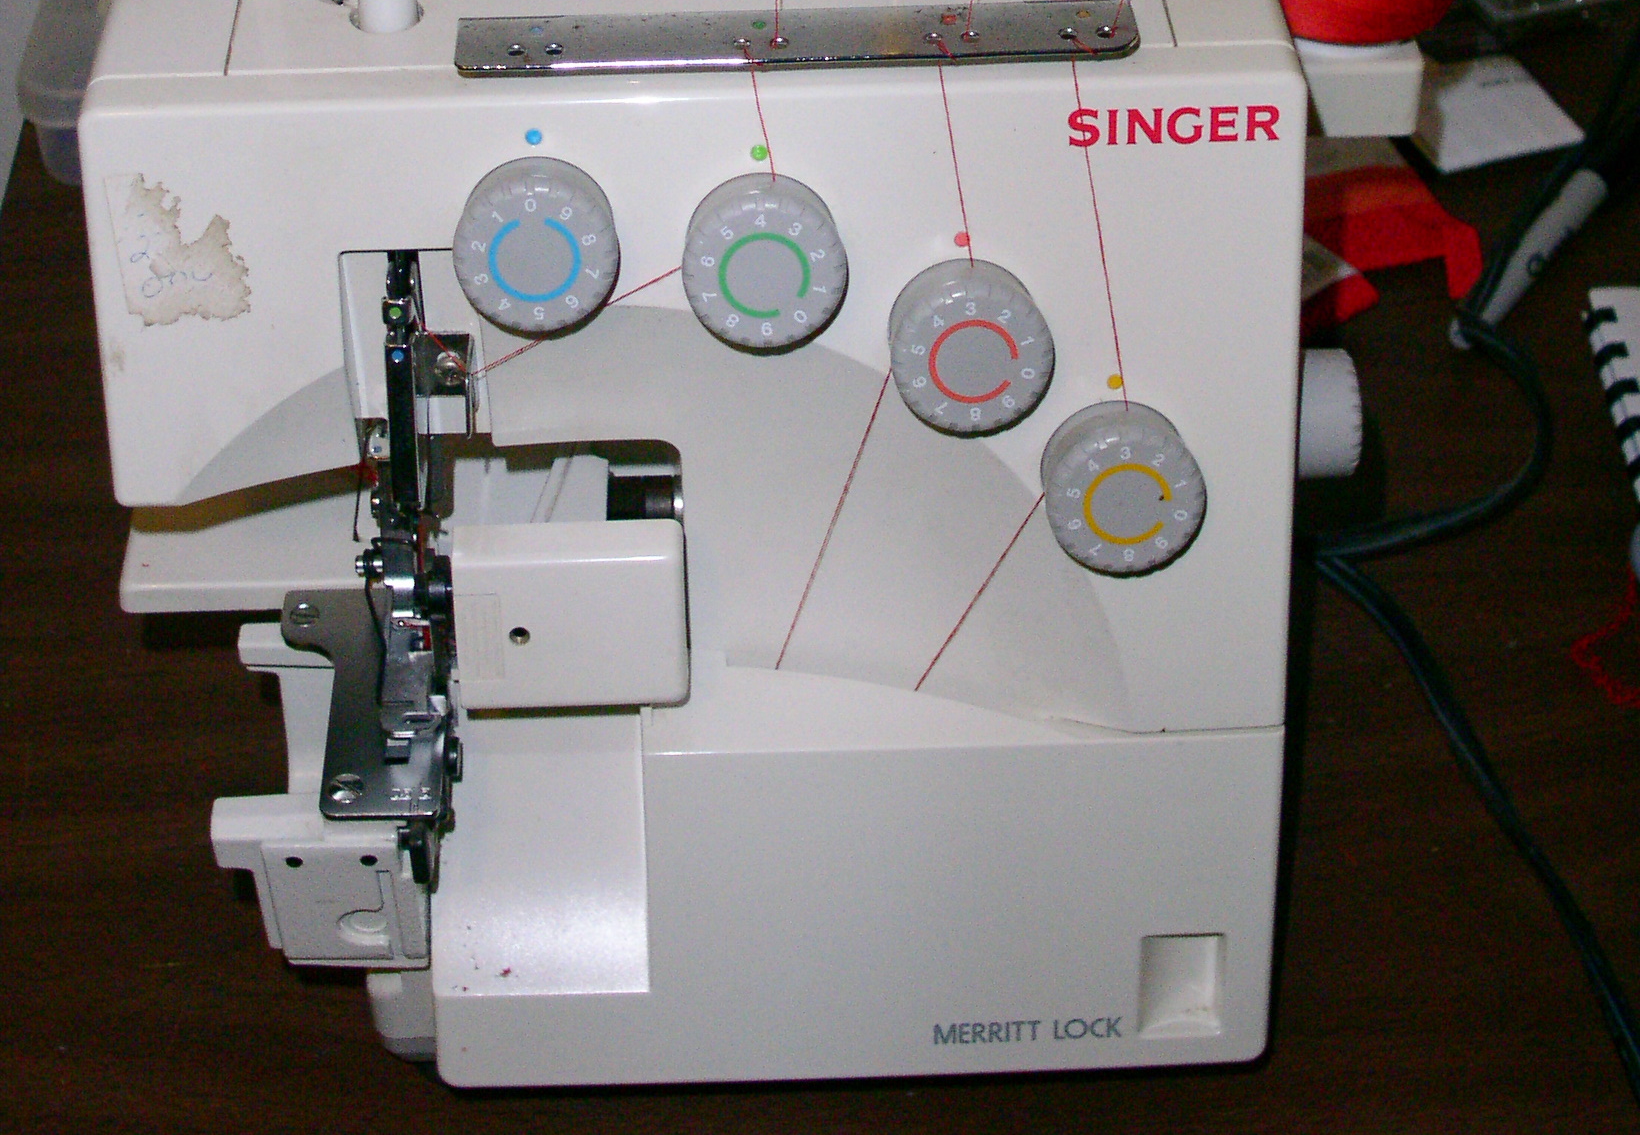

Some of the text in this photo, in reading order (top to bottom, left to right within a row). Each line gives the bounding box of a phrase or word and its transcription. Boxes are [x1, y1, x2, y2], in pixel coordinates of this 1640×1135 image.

[1067, 105, 1280, 147] SINGER
[525, 198, 536, 212] 0
[492, 211, 503, 222] 1
[755, 215, 766, 227] 4
[720, 226, 734, 239] 5
[788, 223, 802, 236] 3
[582, 234, 596, 245] 8
[471, 241, 486, 252] 2
[810, 249, 825, 262] 2
[474, 273, 488, 285] 3
[585, 268, 599, 279] 7
[702, 292, 716, 302] 7
[498, 298, 511, 311] 4
[966, 302, 976, 315] 3
[534, 307, 544, 320] 5
[794, 310, 807, 323] 0
[998, 310, 1011, 323] 2
[726, 314, 739, 327] 8
[933, 316, 944, 327] 4
[1020, 337, 1034, 345] 1
[911, 345, 926, 355] 5
[1021, 368, 1035, 379] 0
[934, 402, 948, 415] 7
[970, 408, 981, 421] 8
[1120, 447, 1131, 460] 3
[1088, 460, 1099, 472] 4
[1153, 454, 1165, 466] 2
[1175, 480, 1187, 488] 1
[1066, 488, 1081, 498] 5
[1175, 510, 1188, 520] 0
[1089, 544, 1101, 556] 7
[1123, 549, 1134, 562] 8
[933, 1016, 1124, 1045] MERRITT LOCK
